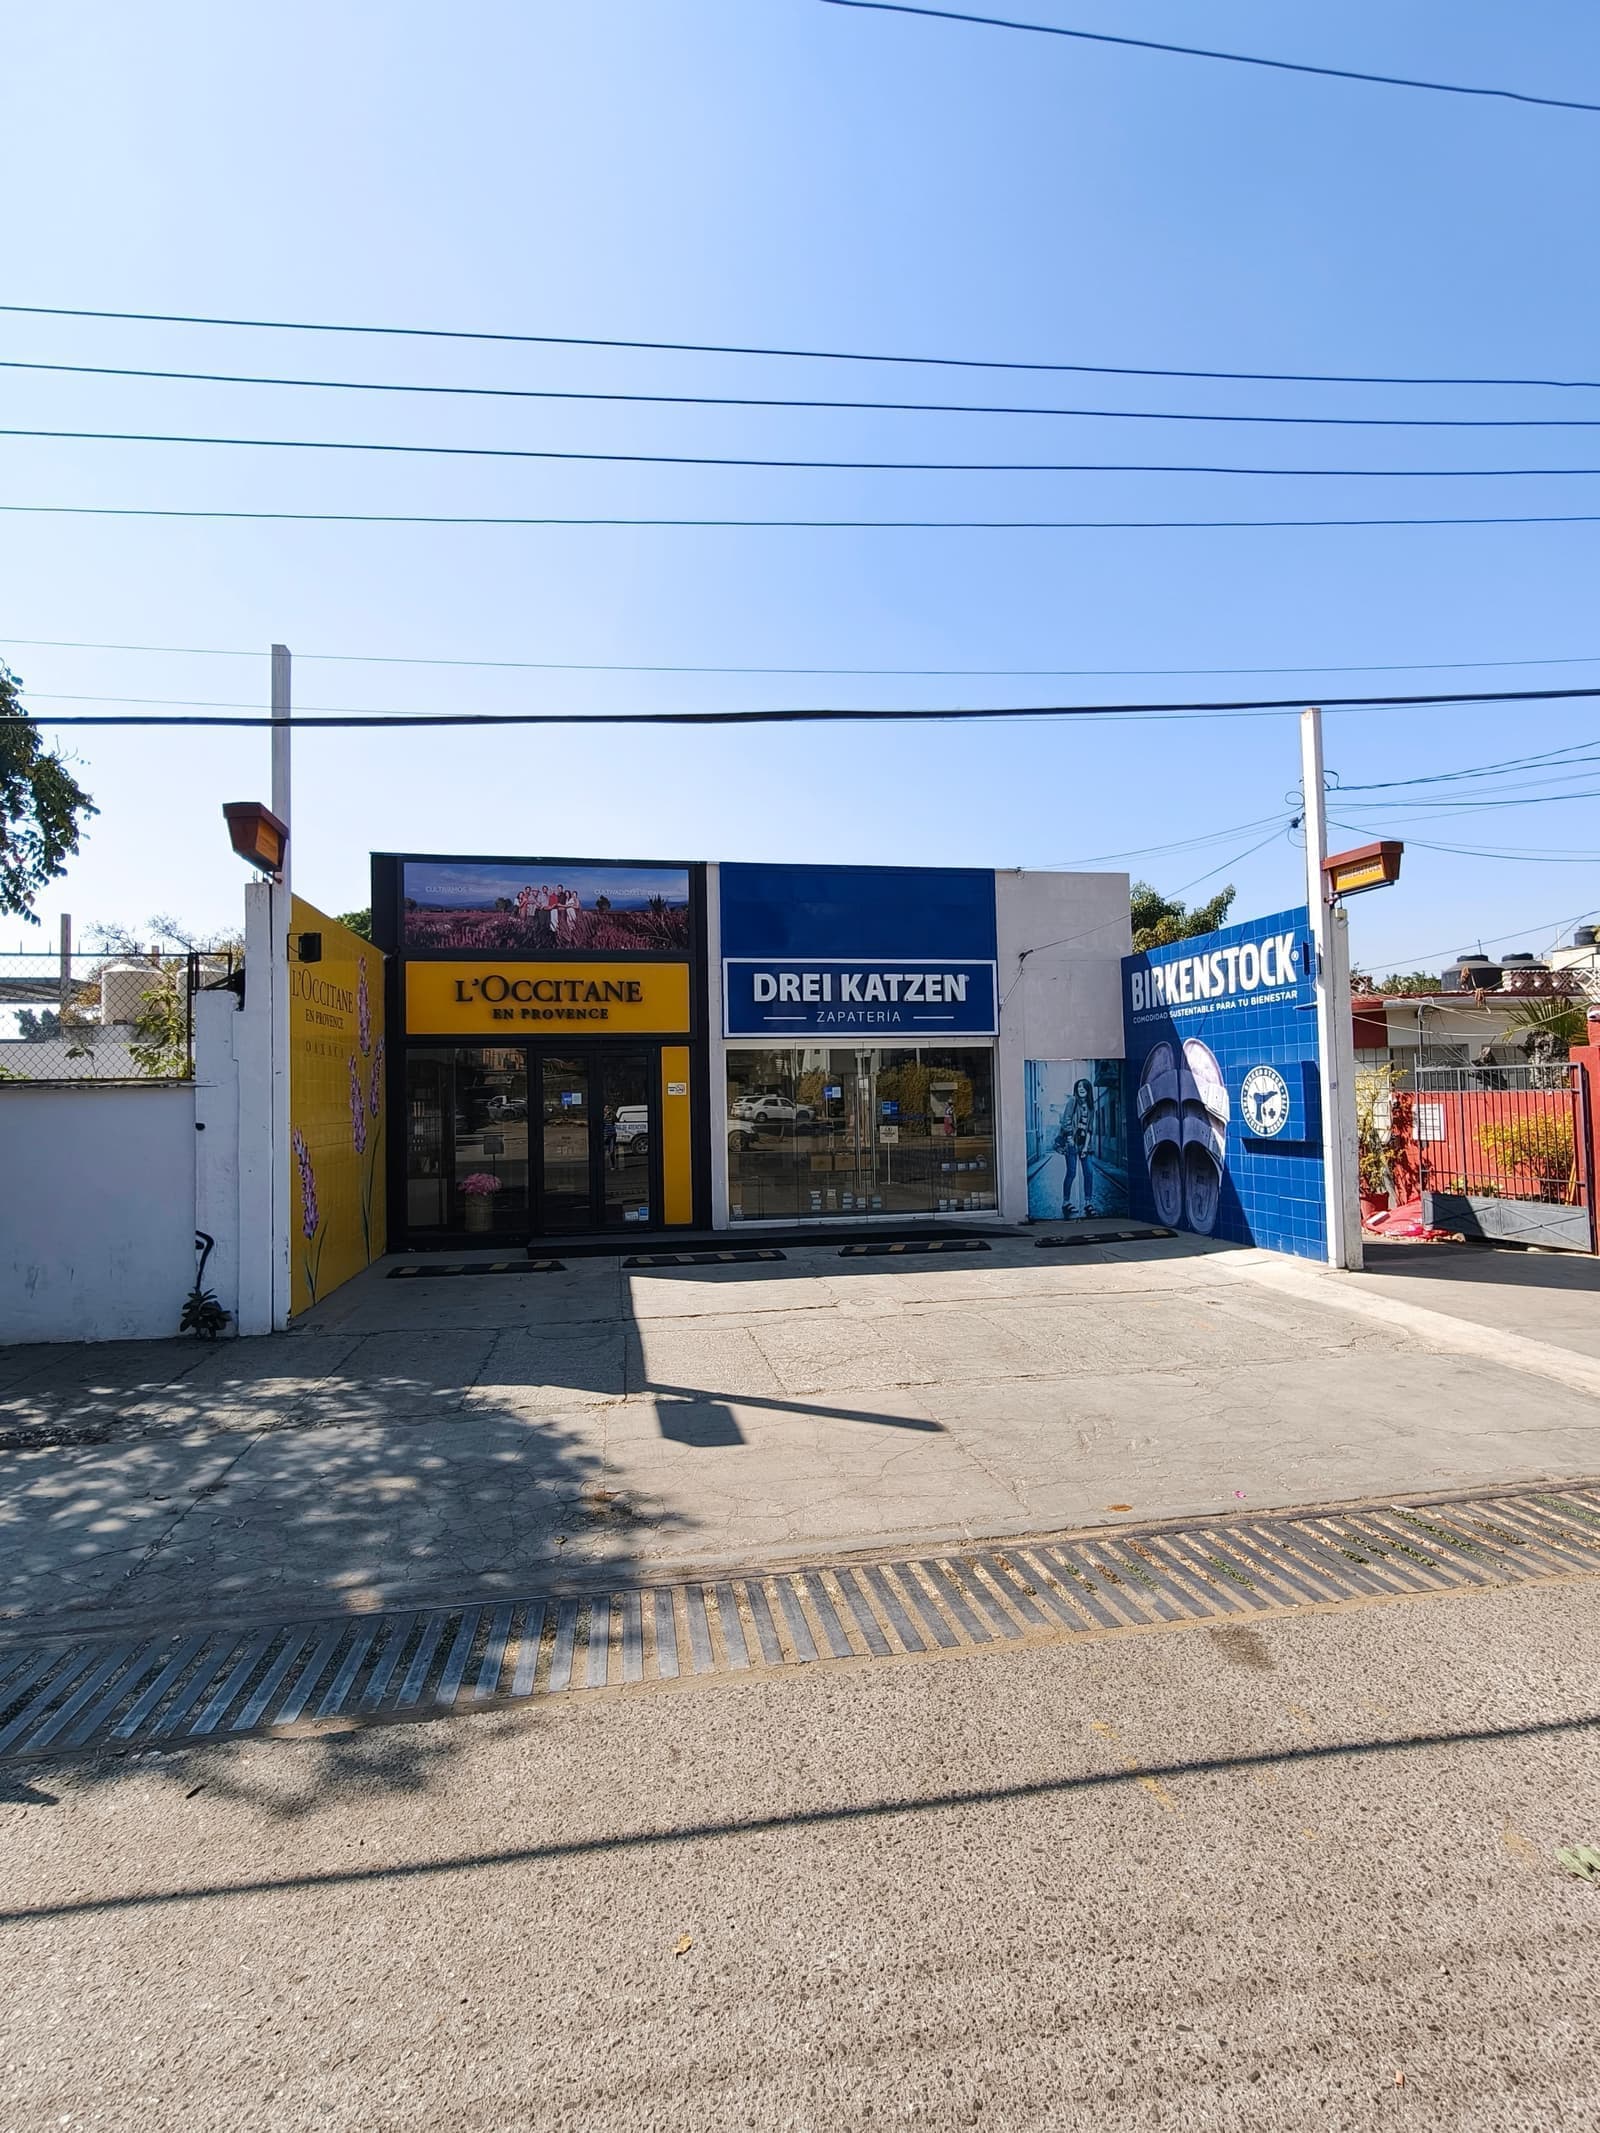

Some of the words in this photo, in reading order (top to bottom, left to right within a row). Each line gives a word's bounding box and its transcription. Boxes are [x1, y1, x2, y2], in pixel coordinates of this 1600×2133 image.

[455, 974, 643, 1003] L'OCCITANE
[753, 973, 832, 1002] DREI
[305, 1008, 315, 1022] EN
[315, 1011, 344, 1030] PROVENCE
[493, 1008, 514, 1020] EN
[521, 1008, 609, 1020] PROVENCE
[816, 1009, 901, 1023] ZAPATERÍA
[1132, 1012, 1168, 1024] COMODIDAD
[1169, 1002, 1215, 1018] SUSTENTABLE
[1216, 1000, 1237, 1011] PARA
[1238, 997, 1249, 1007] TU
[1250, 989, 1298, 1006] BIENESTAR
